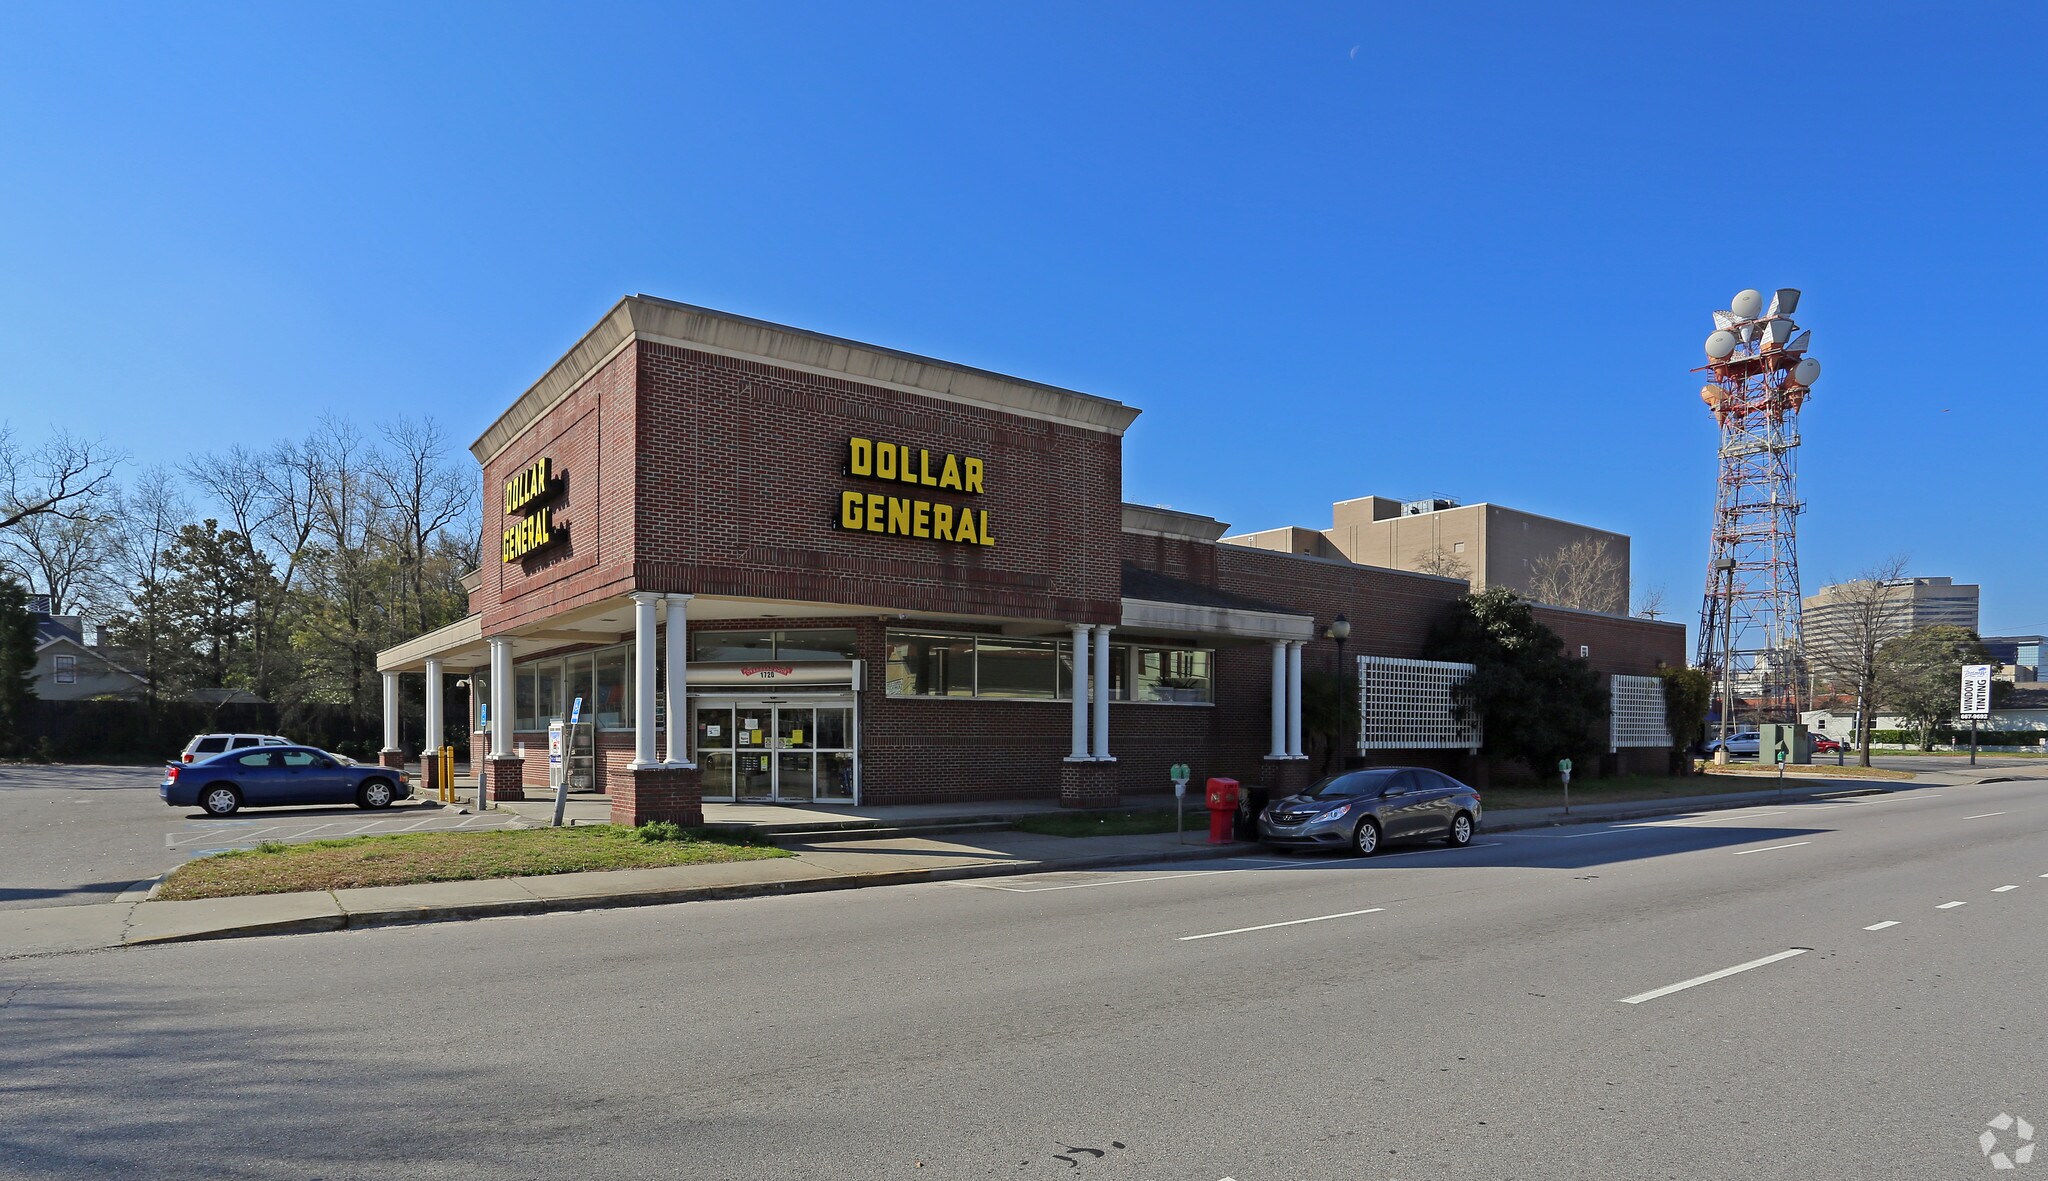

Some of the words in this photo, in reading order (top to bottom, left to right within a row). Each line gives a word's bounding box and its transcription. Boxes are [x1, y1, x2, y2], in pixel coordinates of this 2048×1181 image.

[506, 457, 545, 515] DOLLAR
[850, 437, 984, 494] DOLLAR
[503, 508, 549, 563] GENERAL
[842, 491, 995, 546] GENERAL
[1964, 680, 1974, 711] WINDOW
[1976, 680, 1987, 711] TINTING
